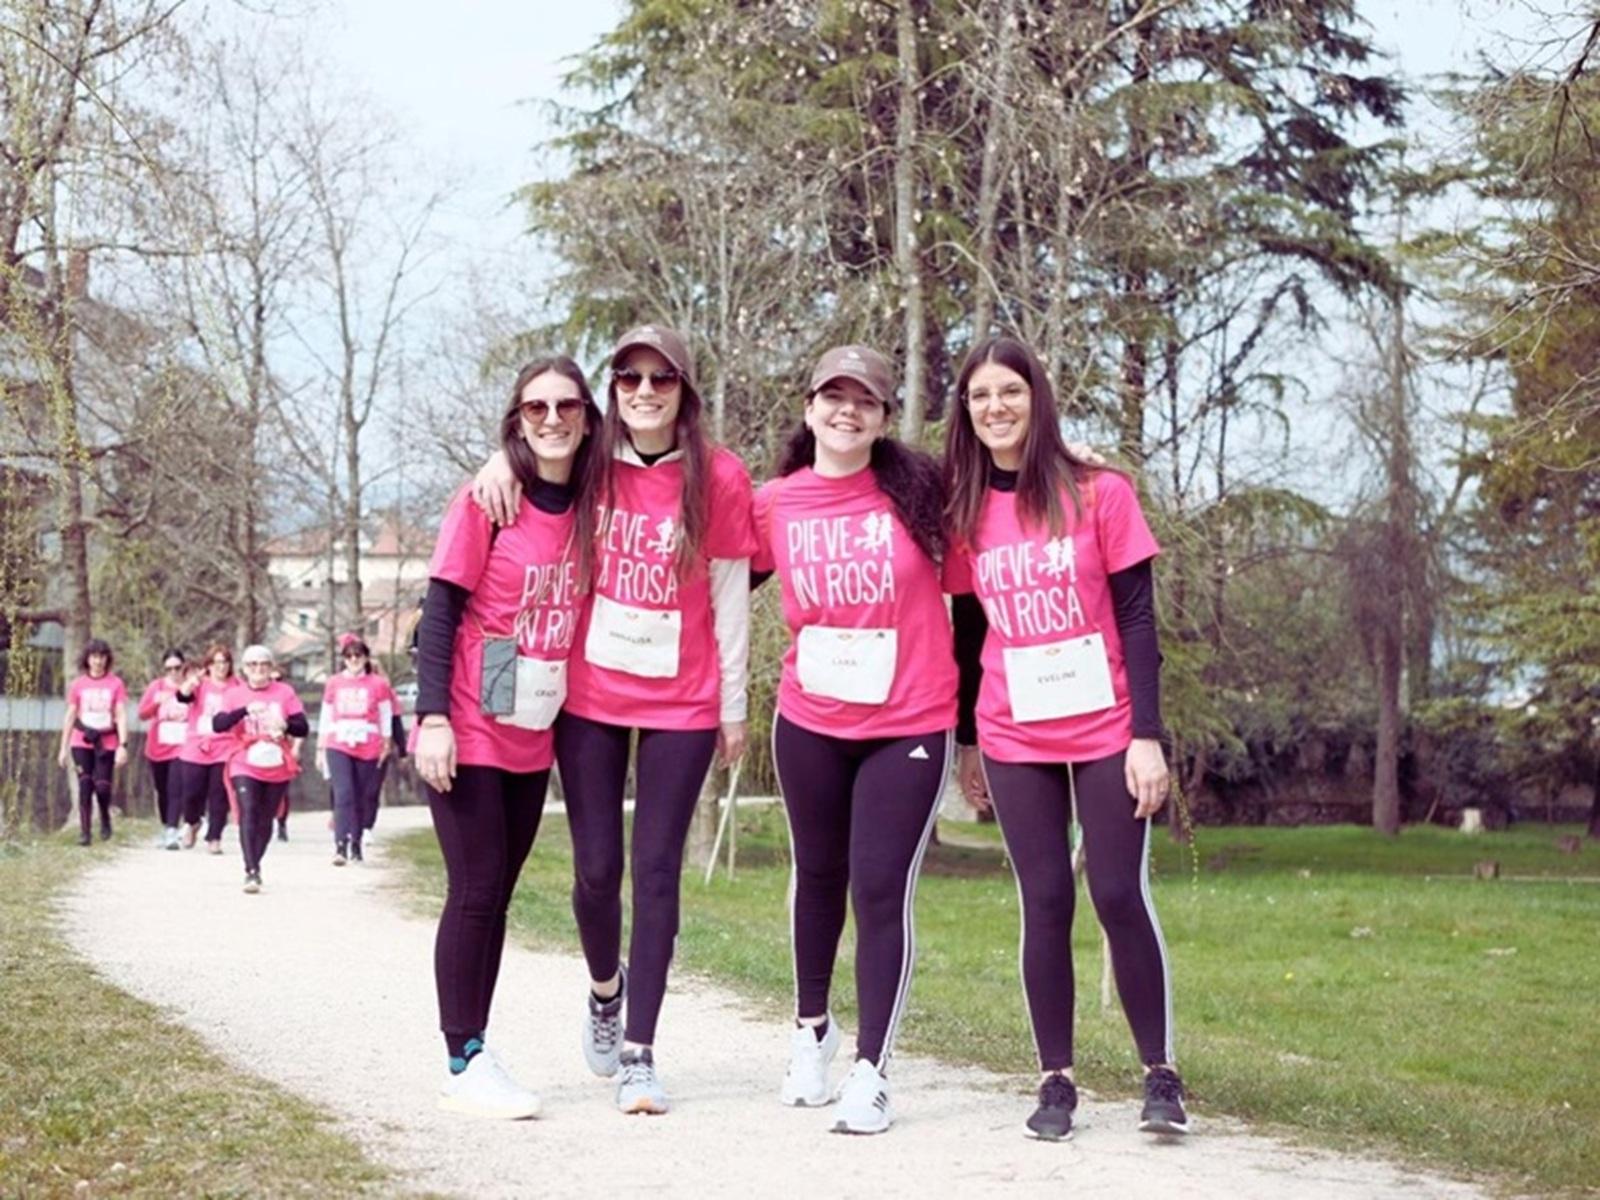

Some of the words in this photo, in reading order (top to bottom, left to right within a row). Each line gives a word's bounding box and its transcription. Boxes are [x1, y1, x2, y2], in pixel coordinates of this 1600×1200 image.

[788, 516, 853, 564] PIEVE
[521, 562, 574, 607] PIEVE
[615, 558, 678, 604] ROSA
[790, 567, 821, 610] IN
[825, 560, 895, 608] ROSA
[977, 541, 1038, 595] PIEVE
[1013, 585, 1086, 638] ROSA
